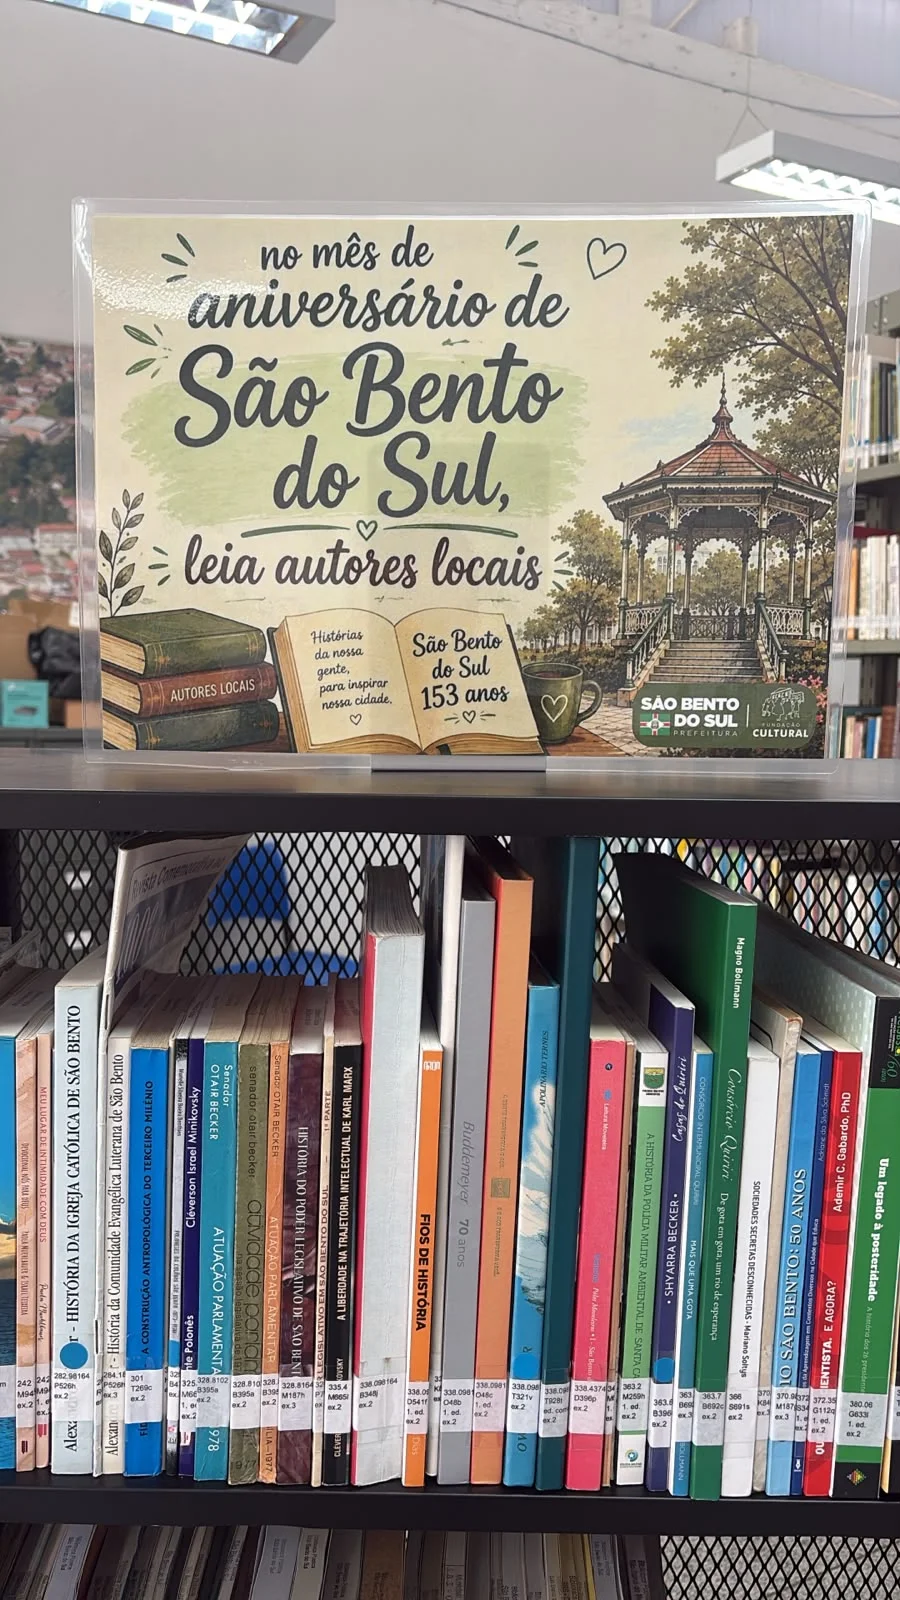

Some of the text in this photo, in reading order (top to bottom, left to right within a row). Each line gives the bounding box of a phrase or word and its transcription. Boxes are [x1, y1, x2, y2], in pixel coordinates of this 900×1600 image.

[261, 225, 433, 270] no mês de
[188, 274, 569, 332] aniversário de
[174, 342, 564, 448] São Bento
[273, 432, 509, 518] do Sul,
[185, 534, 542, 591] leia autores locais
[311, 629, 363, 644] Histórias
[315, 646, 363, 660] da nossa
[412, 628, 503, 658] São Bento
[317, 664, 350, 680] gente,
[431, 655, 490, 678] do Sul
[170, 679, 255, 702] AUTORES LOCAIS
[320, 678, 388, 697] para inspirar
[322, 693, 392, 710] nossa cidade.
[422, 686, 510, 710] 153 anos
[641, 695, 739, 710] SÃO BENTO
[674, 714, 738, 728] DO SUL
[752, 728, 809, 738] CULTURAL
[732, 937, 745, 1008] Magno Bollmann
[223, 1065, 233, 1106] Senador
[343, 1067, 352, 1092] MARX
[142, 1081, 153, 1123] MILÊNIO
[210, 1065, 219, 1140] OTAIR BECKER
[342, 1096, 352, 1118] KARL
[40, 1137, 46, 1147] DE
[342, 1121, 351, 1132] DE
[720, 1068, 742, 1181] Consórcio Quiriri
[64, 1005, 82, 1322] HISTÓRIA DA IGREJA CATÓLICA DE SÃO BENTO
[144, 1126, 153, 1172] TERCEIRO
[185, 1087, 200, 1227] Cléverson Israel Minikovsky
[339, 1136, 351, 1193] INTELECTUAL
[645, 1142, 656, 1183] HISTÓRIA
[833, 1092, 850, 1212] Ademir C. Gabardo, PhD
[143, 1175, 152, 1190] DO
[457, 1121, 474, 1267] Buddemeyer 70 anos
[644, 1185, 652, 1197] DA
[750, 1181, 761, 1224] SOCIEDADES
[107, 1055, 126, 1354] História da Comunidade Evangélica Luterana de São Bento
[336, 1196, 350, 1248] TRAJETÓRIA
[641, 1198, 653, 1231] POLÍCIA
[141, 1193, 152, 1275] ANTROPOLÓGICA
[664, 1200, 680, 1296] SHYARRA BECKER
[749, 1226, 759, 1260] SECRETAS
[867, 1158, 889, 1301] Um legado à posteridade
[339, 1250, 348, 1262] NA
[639, 1234, 649, 1268] MILITAR
[688, 1260, 696, 1276] QUE
[710, 1193, 729, 1340] De gota em gota, um rio de esperança
[780, 1169, 806, 1360] SÃO BENTO: 50 ANOS
[337, 1265, 348, 1312] LIBERDADE
[415, 1214, 430, 1330] FIOS DE HISTÓRIA
[744, 1262, 757, 1320] DESCONHECIDAS
[140, 1279, 152, 1344] CONSTRUÇÃO
[635, 1270, 647, 1320] AMBIENTAL
[686, 1299, 694, 1319] GOTA
[184, 1316, 194, 1352] Polonês
[635, 1322, 644, 1333] DE
[742, 1326, 752, 1354] Mariano
[633, 1338, 642, 1368] SANTA
